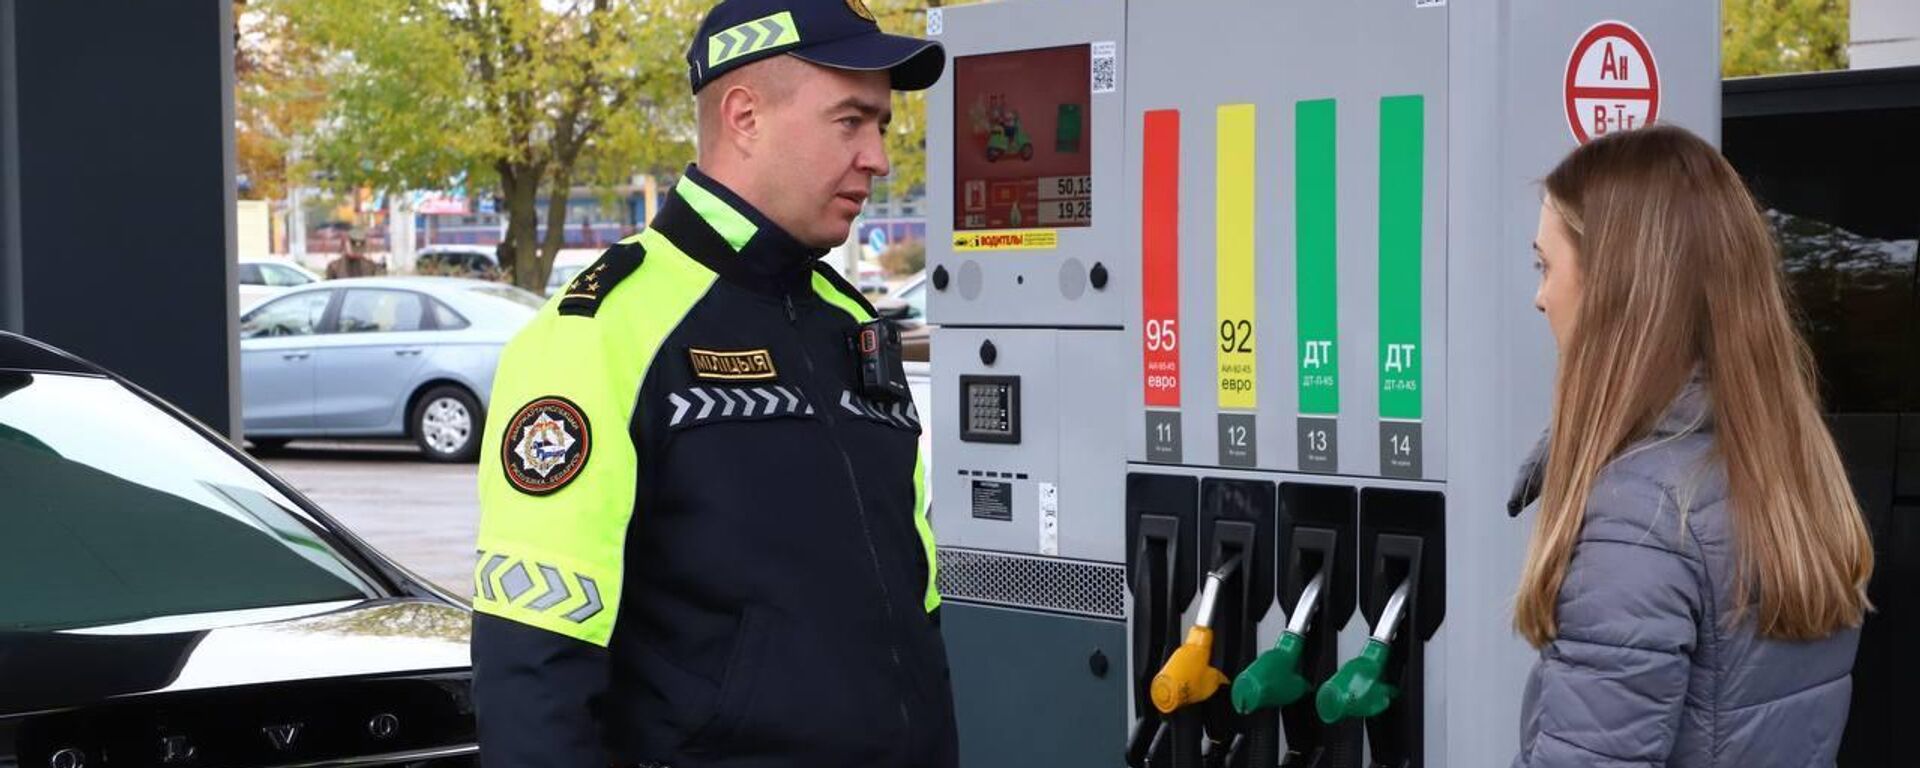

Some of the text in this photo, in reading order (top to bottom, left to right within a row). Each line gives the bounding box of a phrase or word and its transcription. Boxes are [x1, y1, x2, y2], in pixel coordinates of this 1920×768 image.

[1146, 320, 1176, 351] 95
[1221, 320, 1252, 353] 92
[1303, 341, 1332, 368] ДТ
[1385, 344, 1415, 372] ДТ
[1148, 376, 1176, 391] евро
[1222, 379, 1252, 394] евро
[1156, 423, 1172, 442] 11
[1228, 426, 1246, 446] 12
[1308, 430, 1327, 451] 13
[1390, 434, 1411, 456] 14
